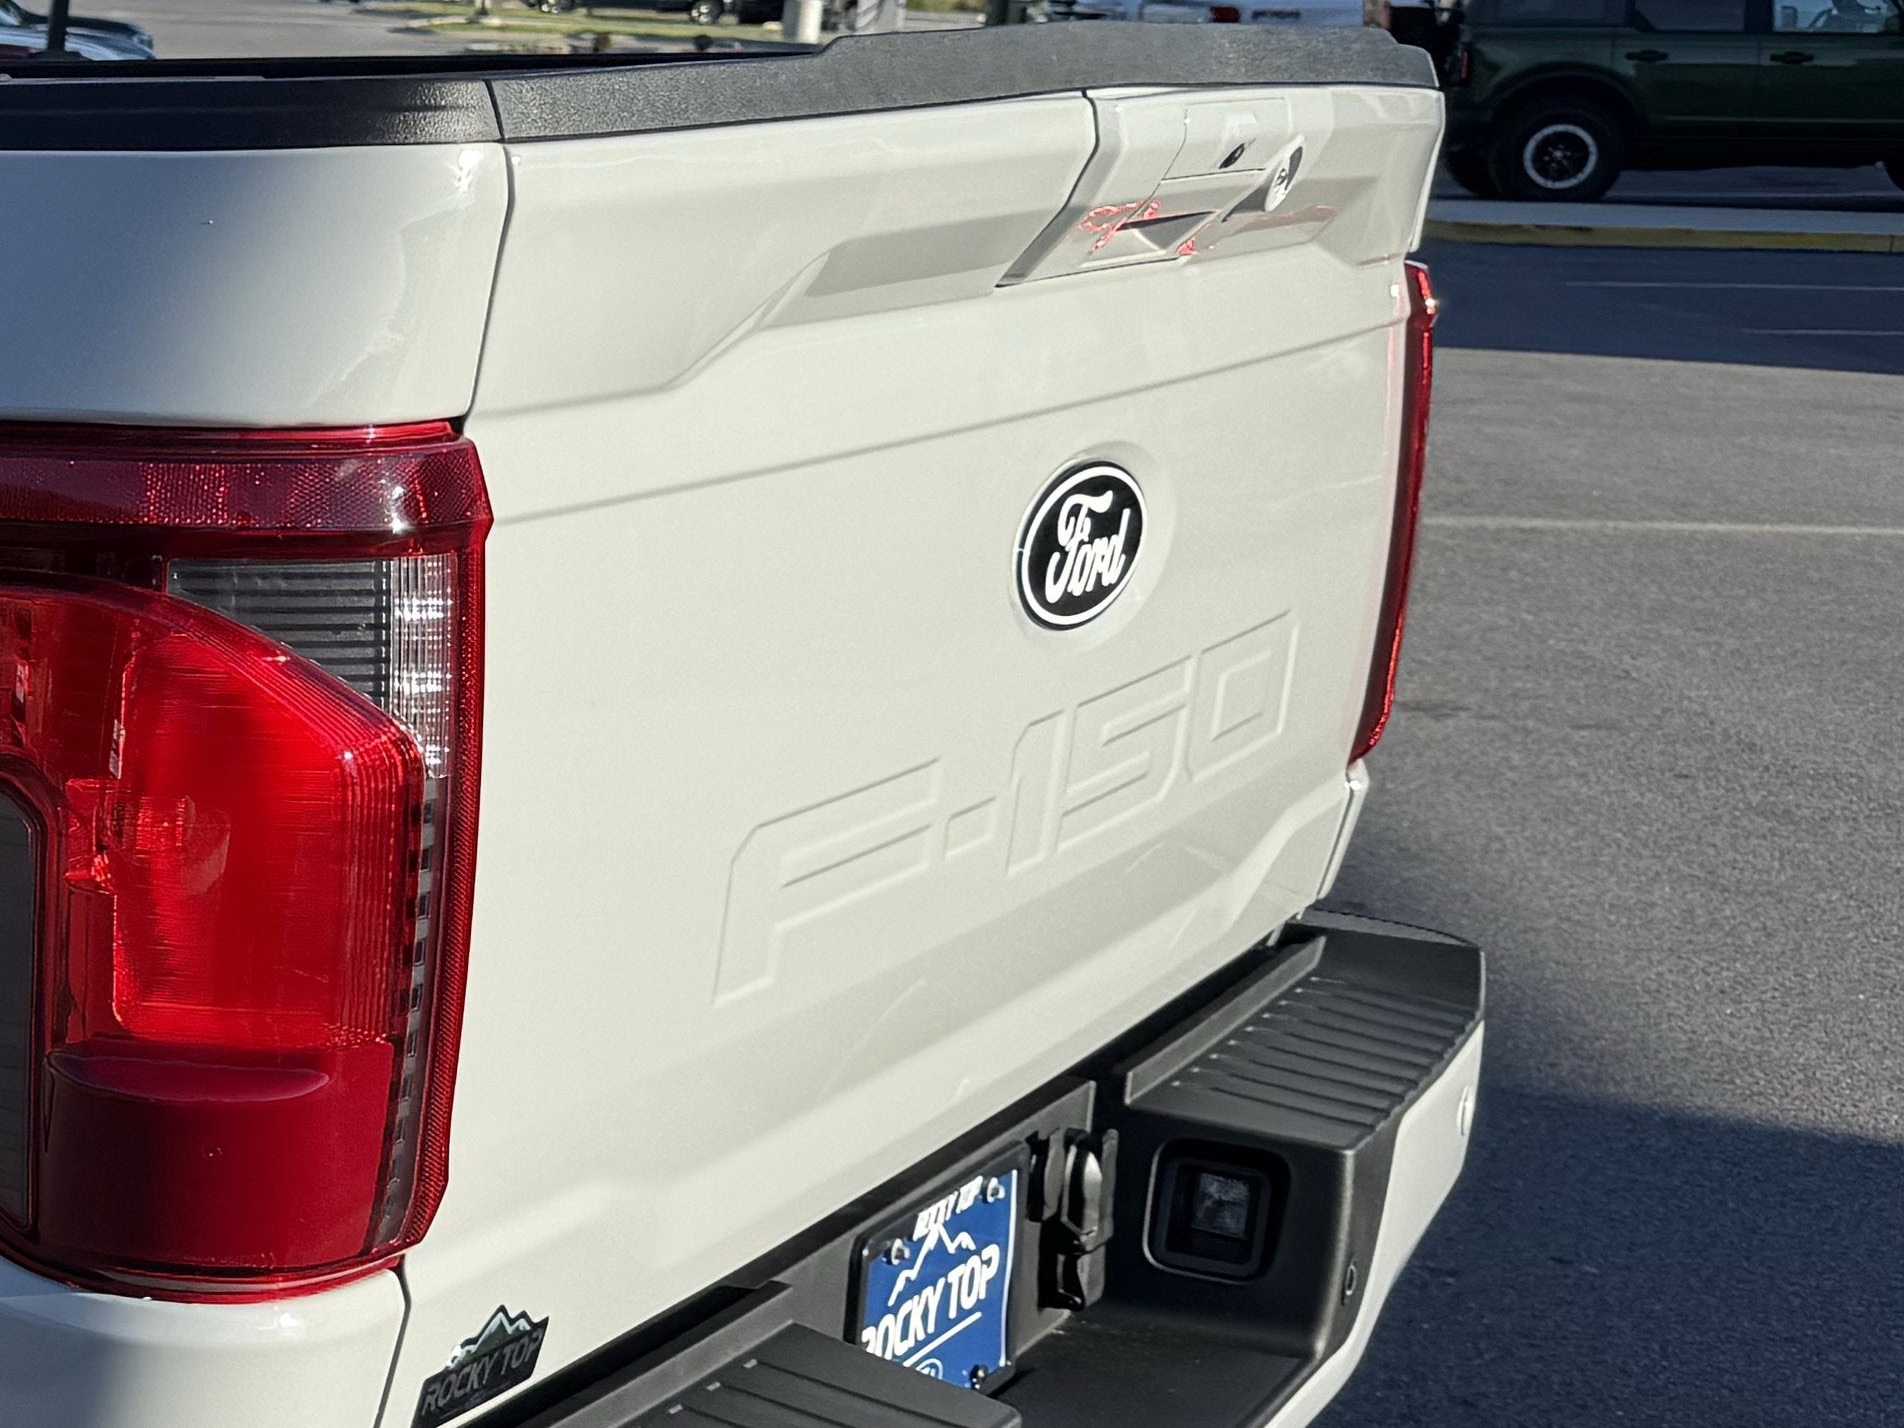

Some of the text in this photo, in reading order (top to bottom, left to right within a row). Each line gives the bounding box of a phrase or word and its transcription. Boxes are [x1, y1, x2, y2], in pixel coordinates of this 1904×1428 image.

[1045, 489, 1131, 604] Ford
[711, 609, 1298, 1009] F-150
[947, 1243, 1000, 1319] TOP
[421, 1327, 542, 1416] ROCKY TOP
